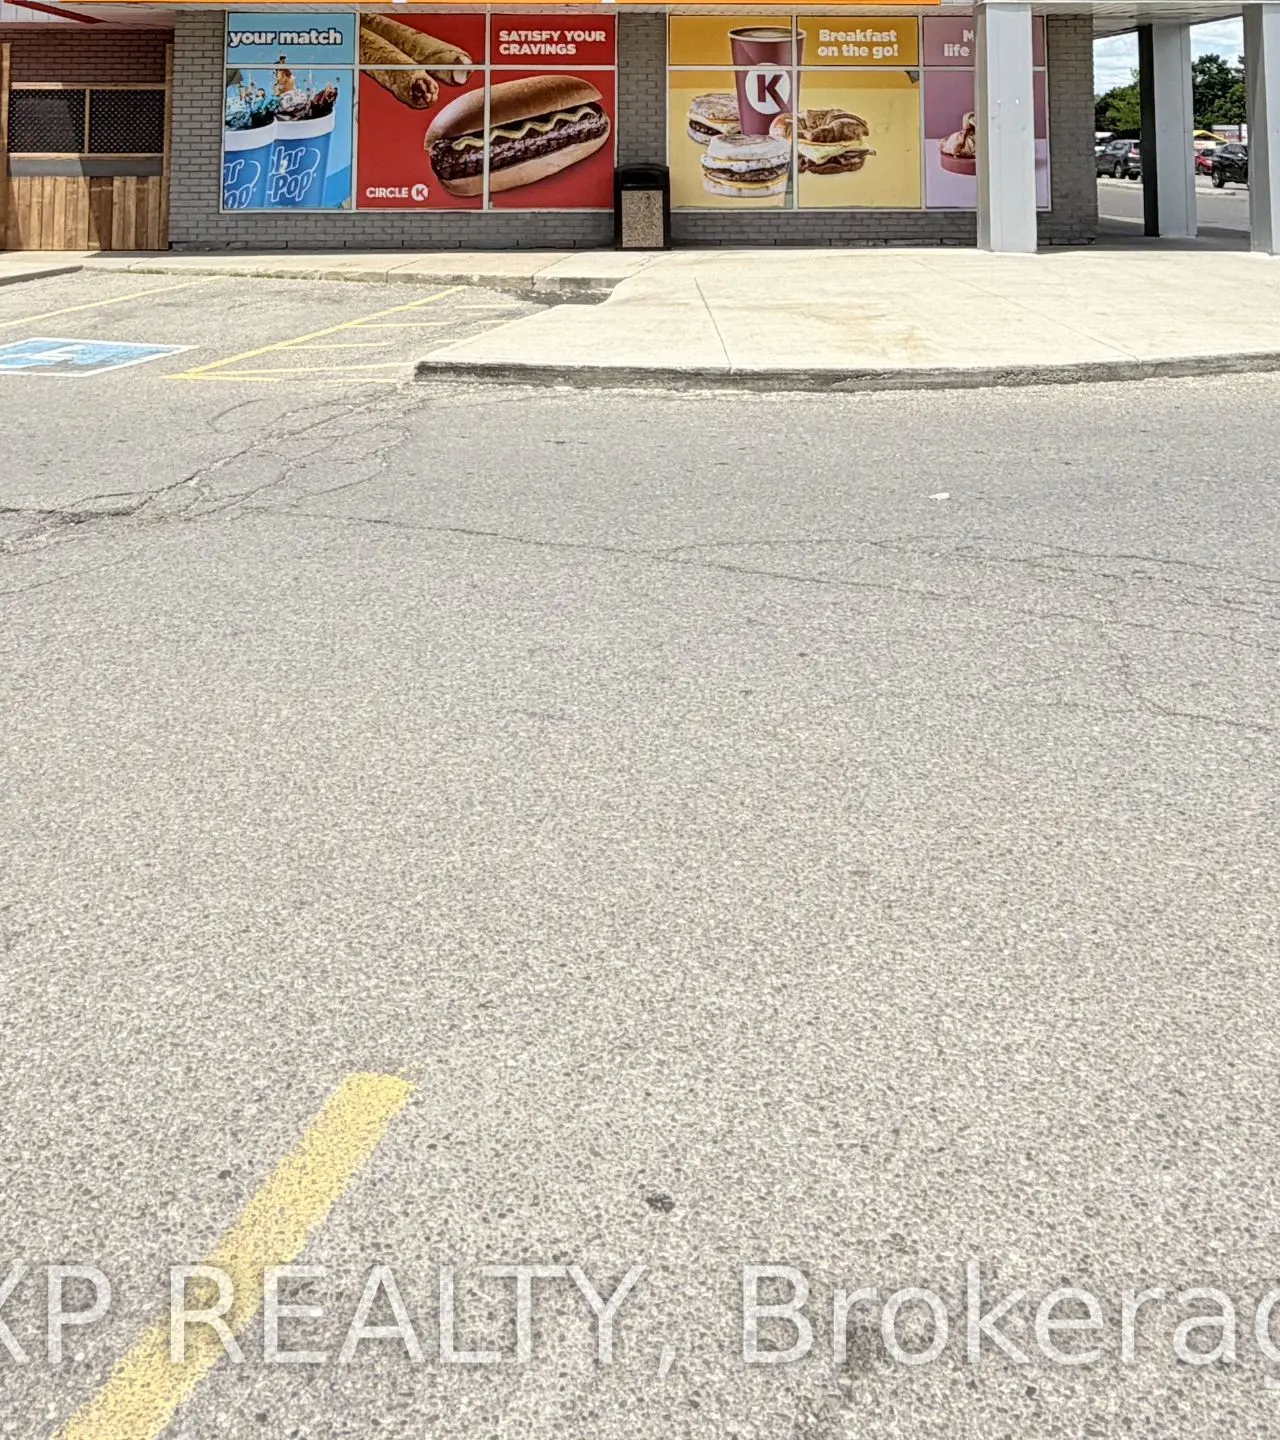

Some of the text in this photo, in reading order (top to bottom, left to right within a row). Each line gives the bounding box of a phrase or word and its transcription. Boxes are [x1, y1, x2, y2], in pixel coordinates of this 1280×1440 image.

[228, 27, 343, 48] your match
[499, 30, 606, 42] SATISFY YOUR
[819, 28, 897, 42] Breakfast
[499, 43, 577, 55] CRAVINGS
[817, 43, 899, 59] on the go!
[943, 43, 971, 57] life
[751, 70, 792, 113] K
[365, 185, 427, 201] CIRCLE K
